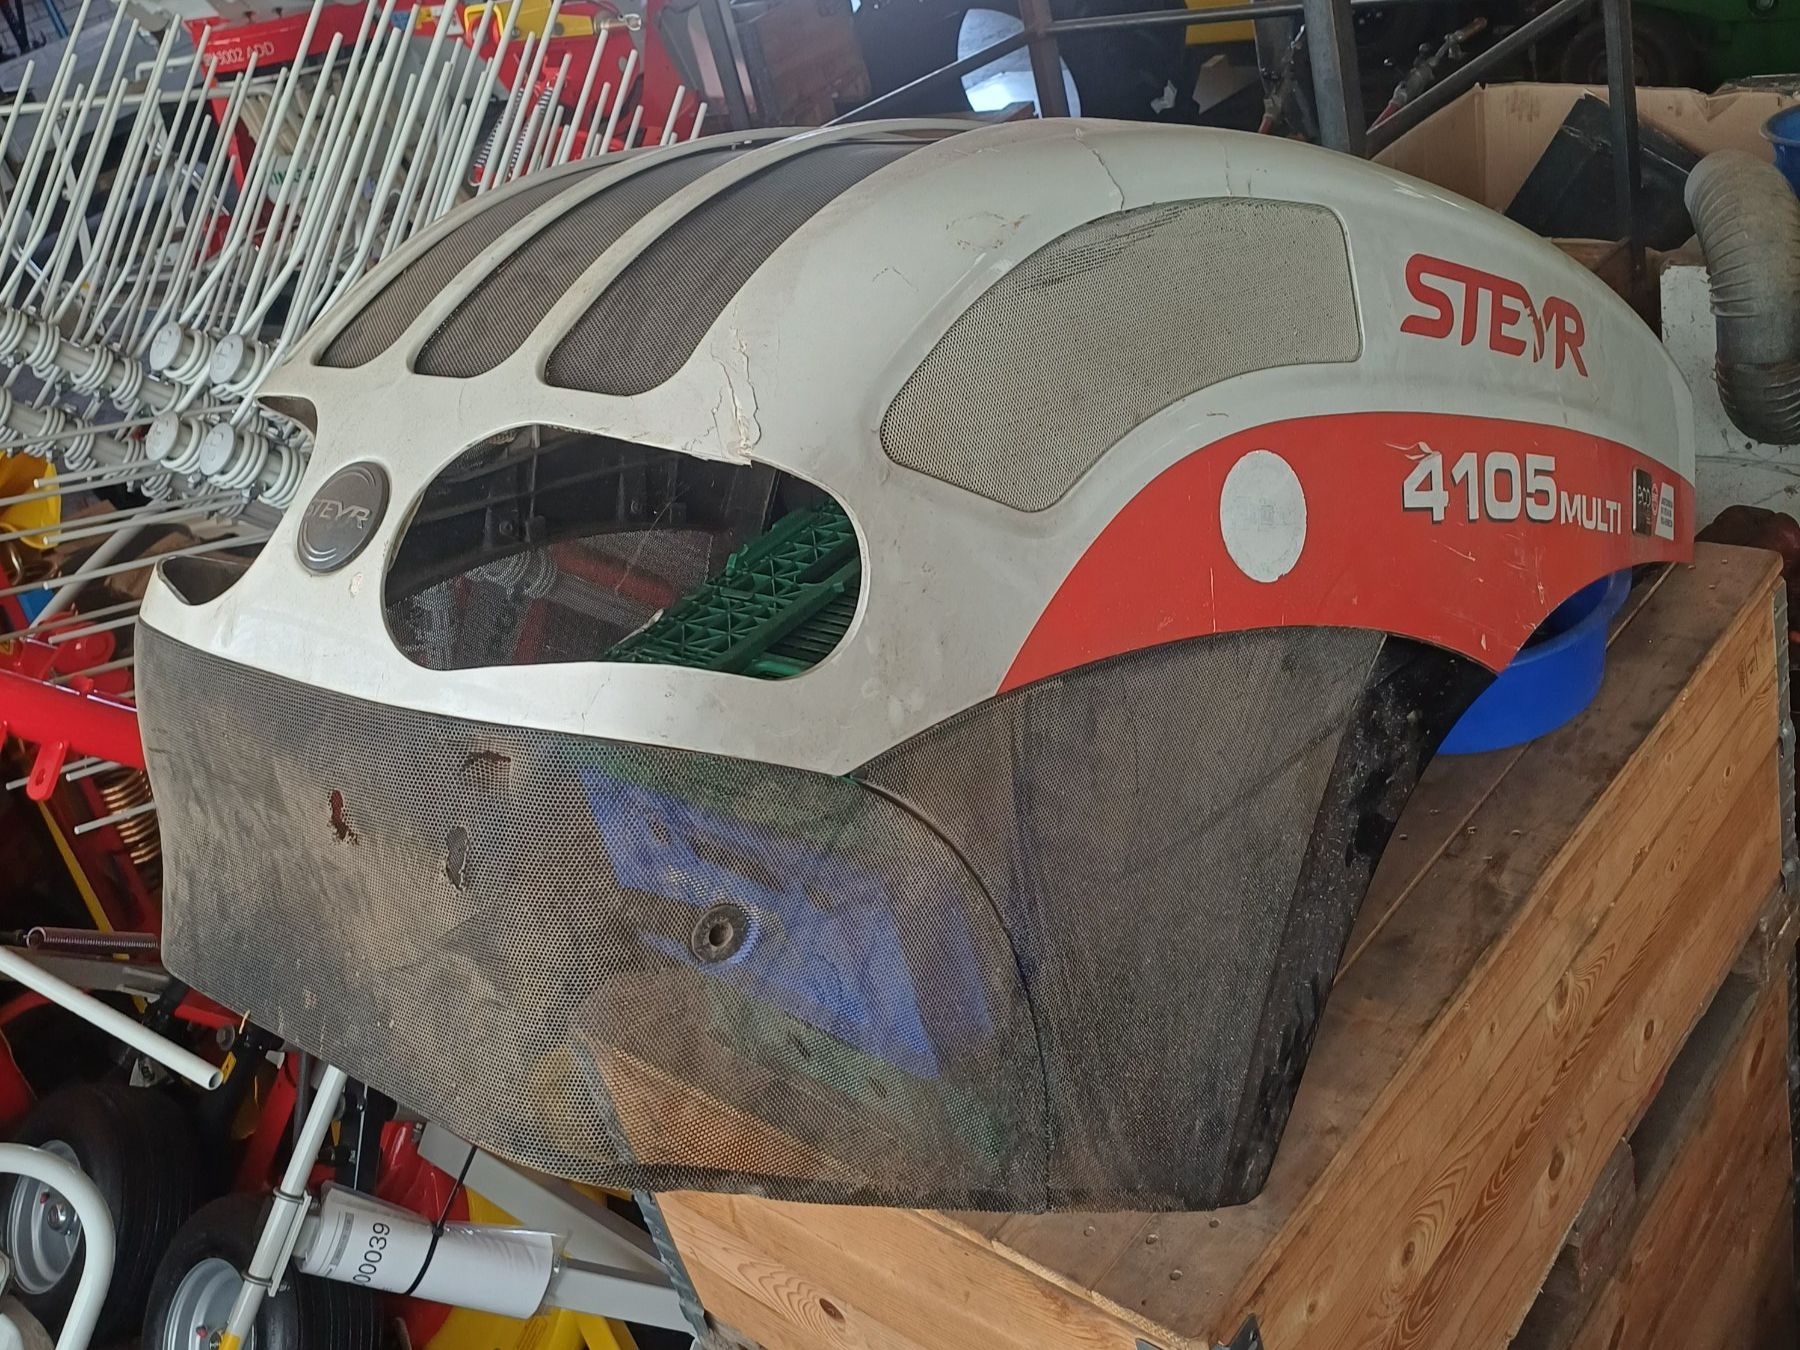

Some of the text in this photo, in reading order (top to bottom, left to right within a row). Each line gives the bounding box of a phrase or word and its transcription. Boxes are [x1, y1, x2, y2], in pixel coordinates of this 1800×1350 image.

[1401, 253, 1588, 377] STEYR
[1402, 450, 1557, 523] 4105
[1559, 490, 1622, 534] MULTI
